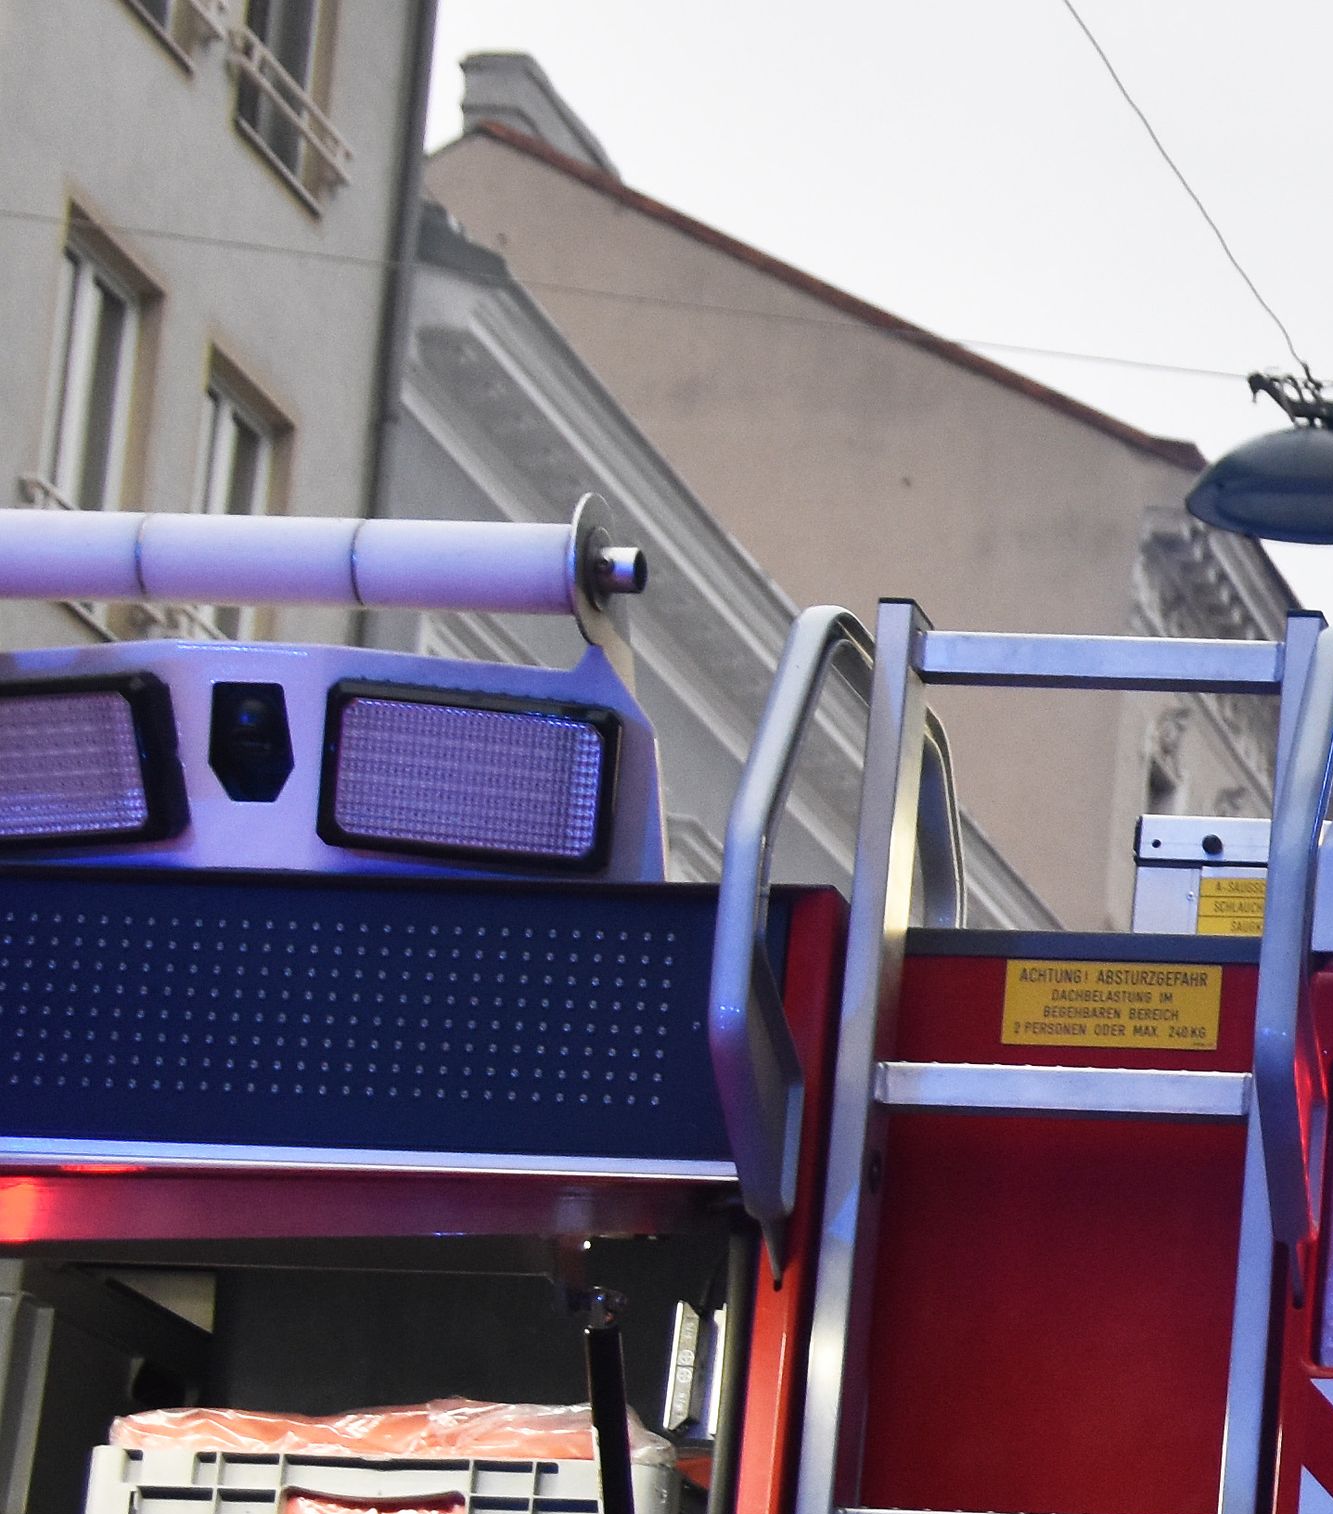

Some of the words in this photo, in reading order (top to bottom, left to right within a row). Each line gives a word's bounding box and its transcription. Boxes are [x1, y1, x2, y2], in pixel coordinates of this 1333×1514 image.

[1019, 967, 1088, 984] ACHTUNG!
[1097, 969, 1208, 988] ABSTURZGEFAHR
[1051, 989, 1152, 1003] DACHBELASTUNG
[1159, 992, 1173, 1003] IM
[1043, 1005, 1121, 1019] BEGEHBAREN
[1129, 1007, 1179, 1021] BEREICH
[1024, 1021, 1087, 1036] PERSONEN
[1094, 1024, 1126, 1037] ODER
